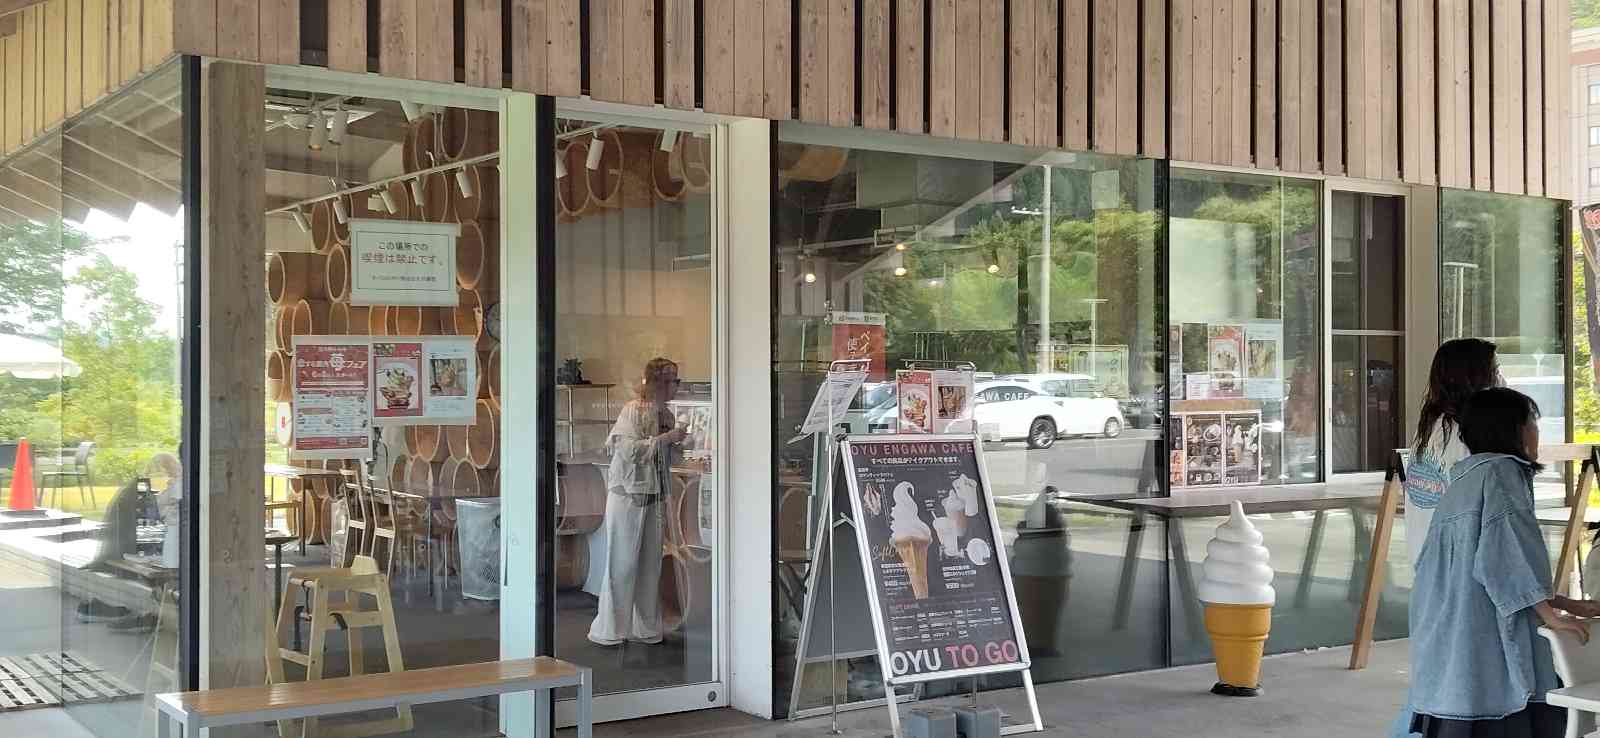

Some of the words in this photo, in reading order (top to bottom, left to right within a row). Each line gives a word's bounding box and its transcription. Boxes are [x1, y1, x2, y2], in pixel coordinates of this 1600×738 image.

[851, 444, 878, 456] OYU
[884, 443, 937, 456] ENGAWA
[942, 443, 974, 454] CAFE
[891, 647, 942, 676] OYU
[945, 643, 979, 668] TO
[984, 639, 1018, 664] GO
